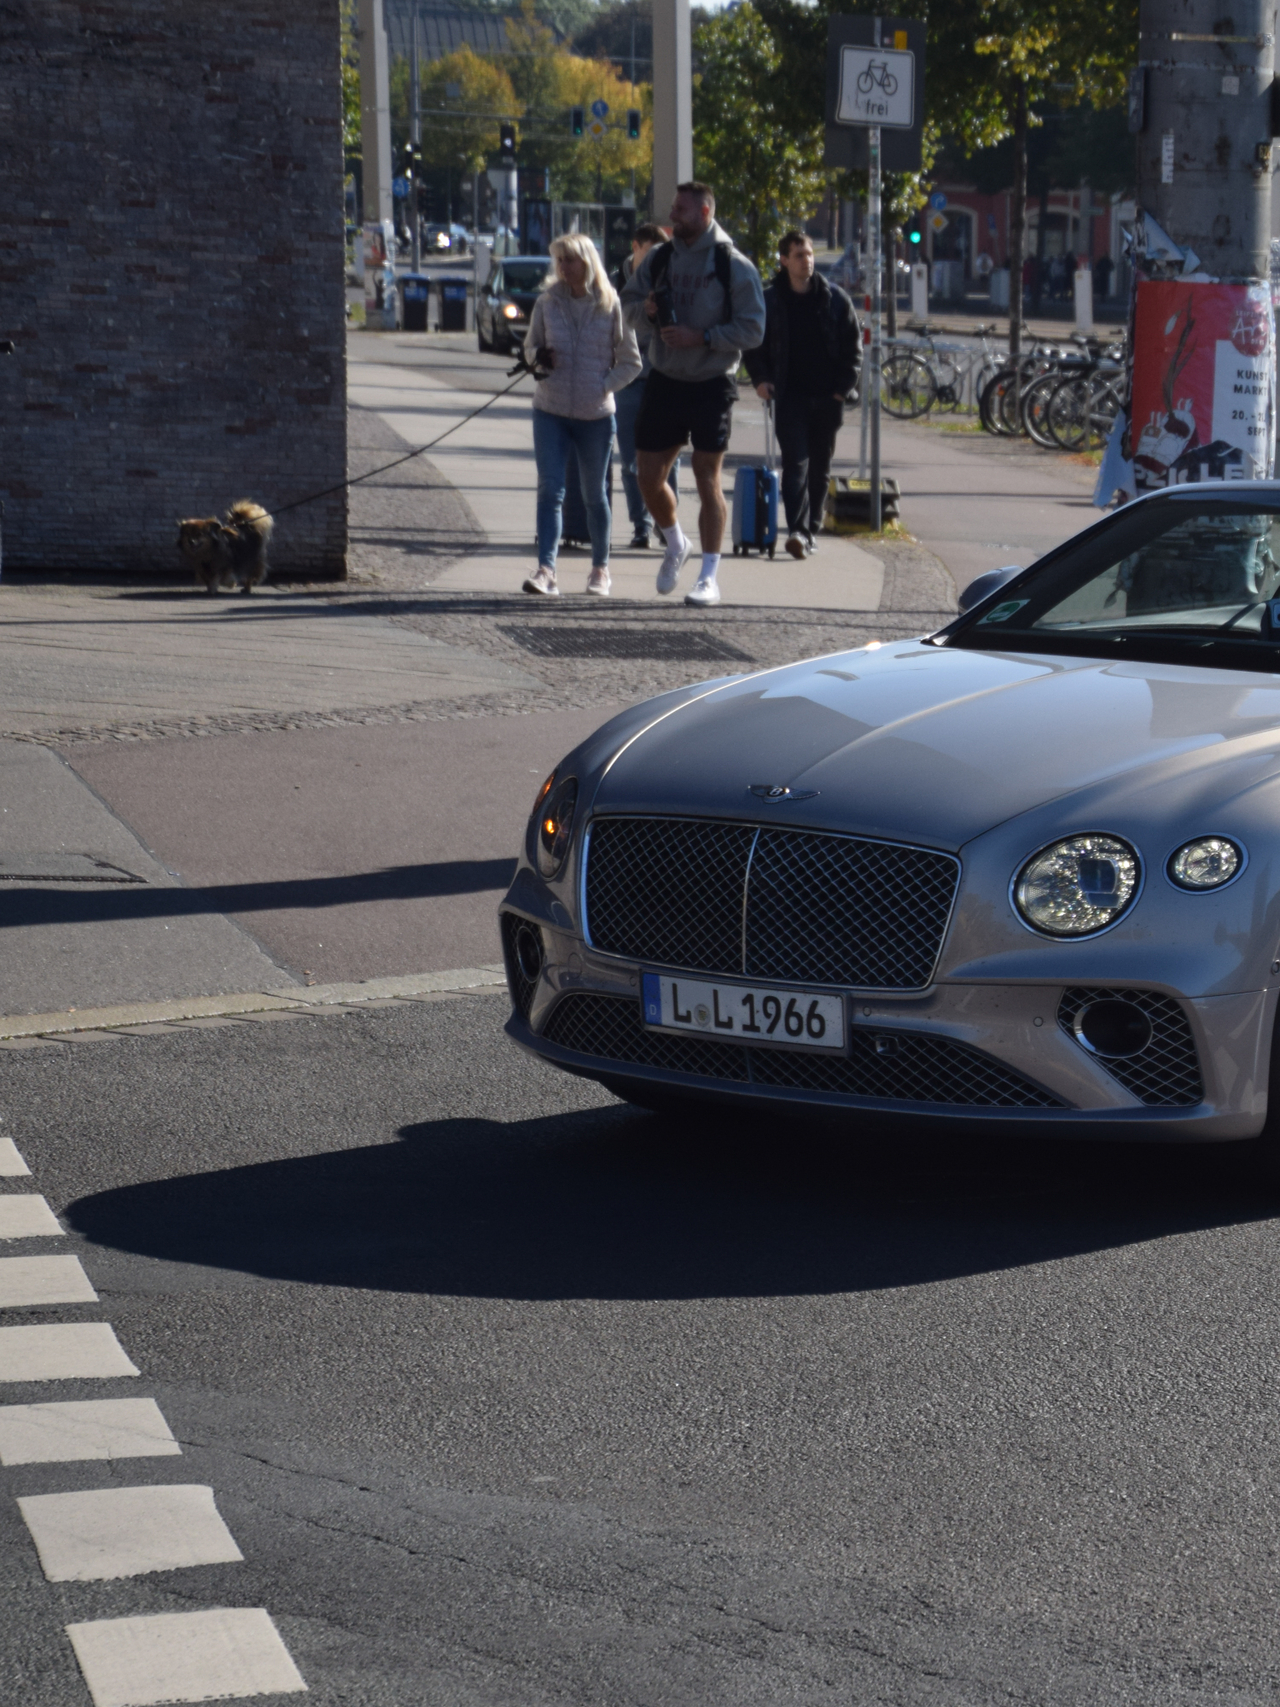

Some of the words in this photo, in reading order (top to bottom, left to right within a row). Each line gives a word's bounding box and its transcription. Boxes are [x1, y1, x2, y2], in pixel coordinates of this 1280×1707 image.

[866, 98, 888, 115] frei
[1237, 369, 1268, 381] KUNST
[1233, 384, 1268, 396] MARKT
[1232, 410, 1248, 421] 20.
[1247, 426, 1266, 437] SEPT
